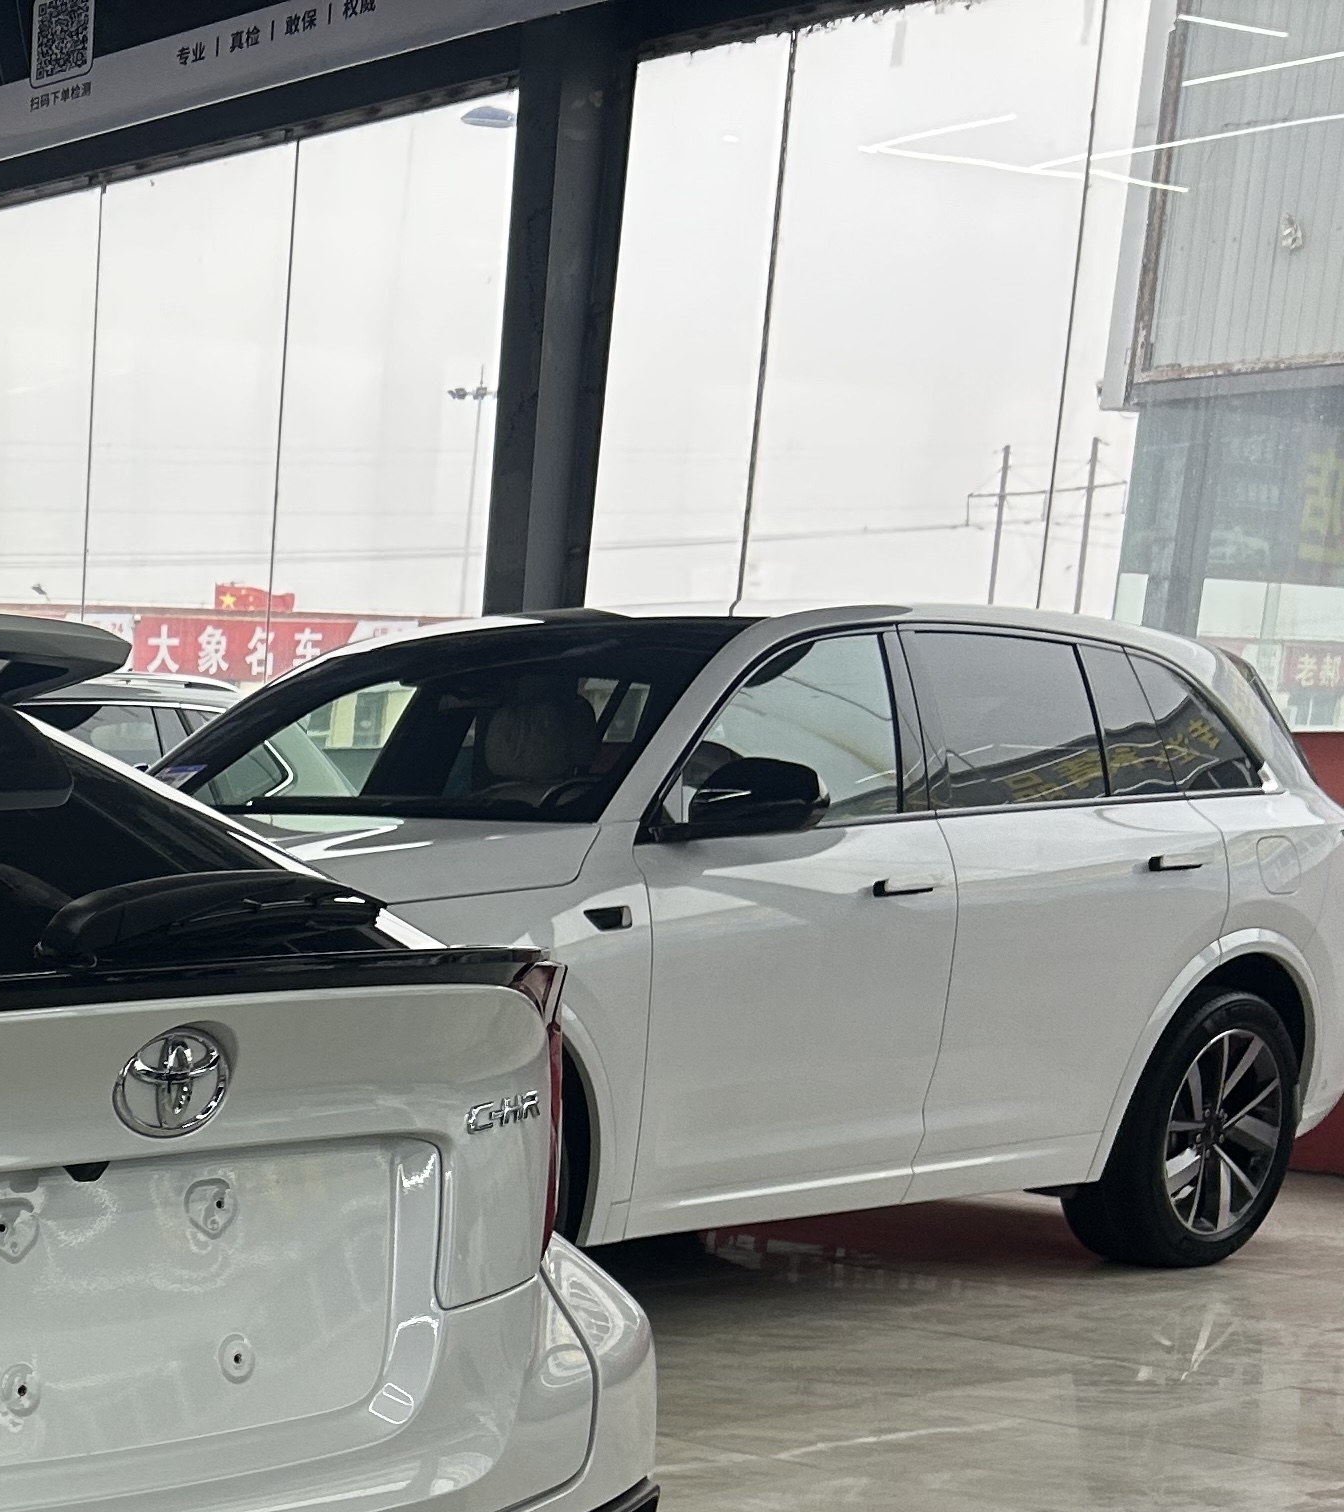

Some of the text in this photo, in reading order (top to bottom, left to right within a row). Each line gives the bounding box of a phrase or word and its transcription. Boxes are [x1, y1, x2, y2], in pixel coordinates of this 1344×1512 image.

[176, 42, 206, 66] 专业
[230, 25, 260, 53] 真检
[285, 8, 317, 36] 敢保
[30, 81, 92, 112] 扫码下单检测
[147, 624, 323, 676] 大象名车
[465, 1090, 540, 1134] C-HR
